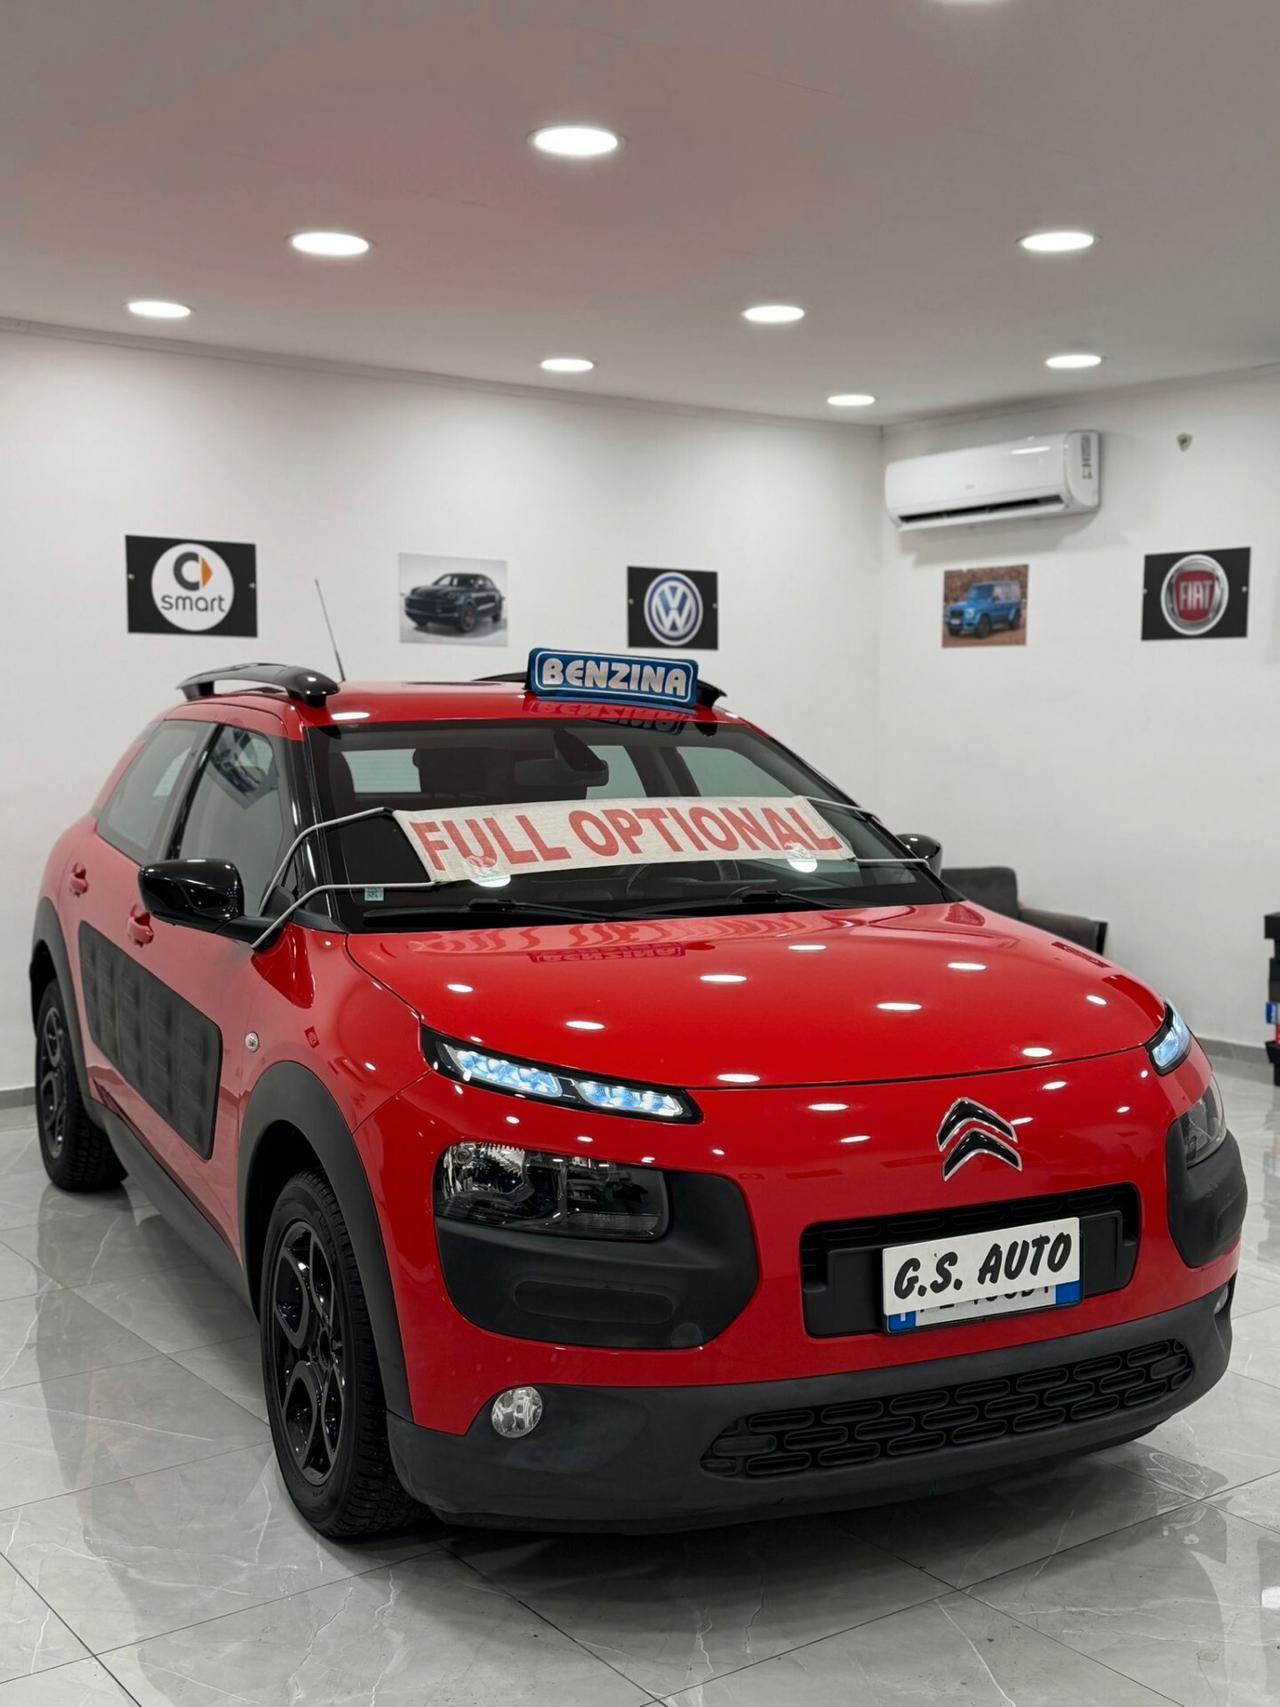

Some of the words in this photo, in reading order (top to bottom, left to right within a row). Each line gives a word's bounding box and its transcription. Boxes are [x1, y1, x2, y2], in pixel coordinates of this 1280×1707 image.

[161, 595, 225, 612] smart
[1179, 580, 1213, 610] FIAT
[542, 658, 687, 697] BENZINA
[412, 815, 569, 870] FULL
[569, 806, 842, 856] OPTIONAL
[894, 1252, 962, 1299] G.S.
[977, 1232, 1072, 1285] AUTO
